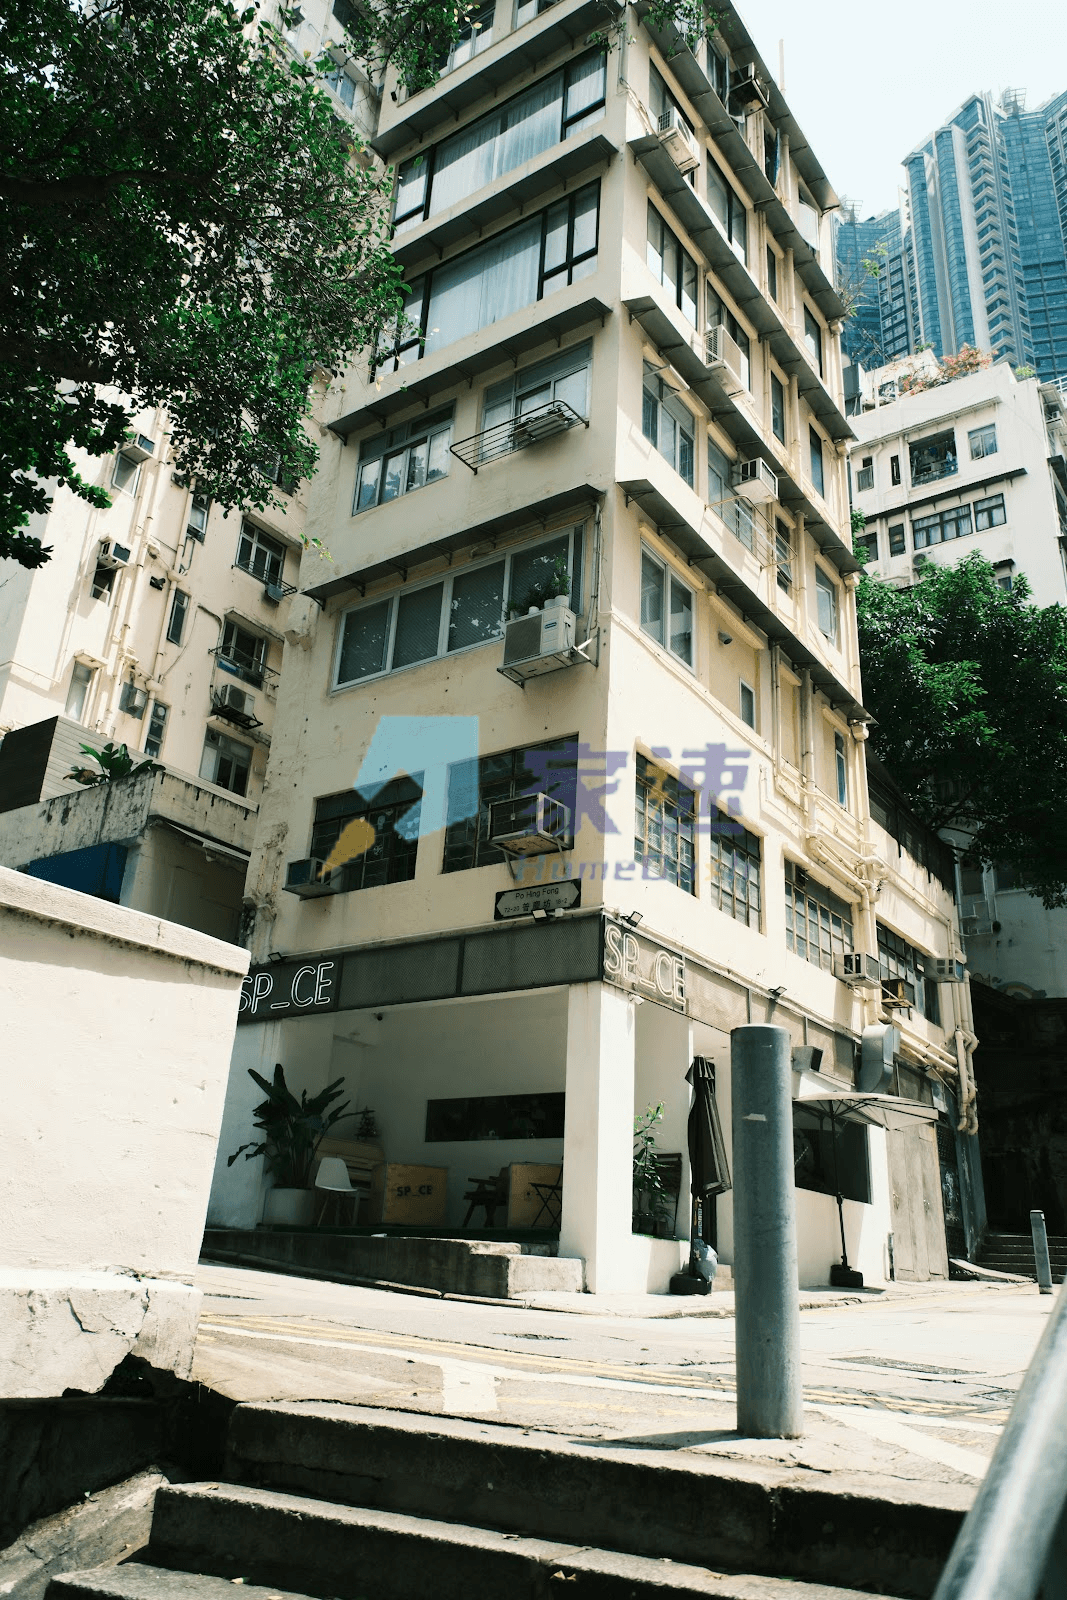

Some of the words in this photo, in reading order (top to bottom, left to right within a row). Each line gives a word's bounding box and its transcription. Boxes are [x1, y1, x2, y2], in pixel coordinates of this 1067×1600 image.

[515, 892, 525, 900] Po
[526, 890, 541, 899] Hing
[542, 887, 559, 896] Fong
[603, 925, 686, 1005] SP_CE
